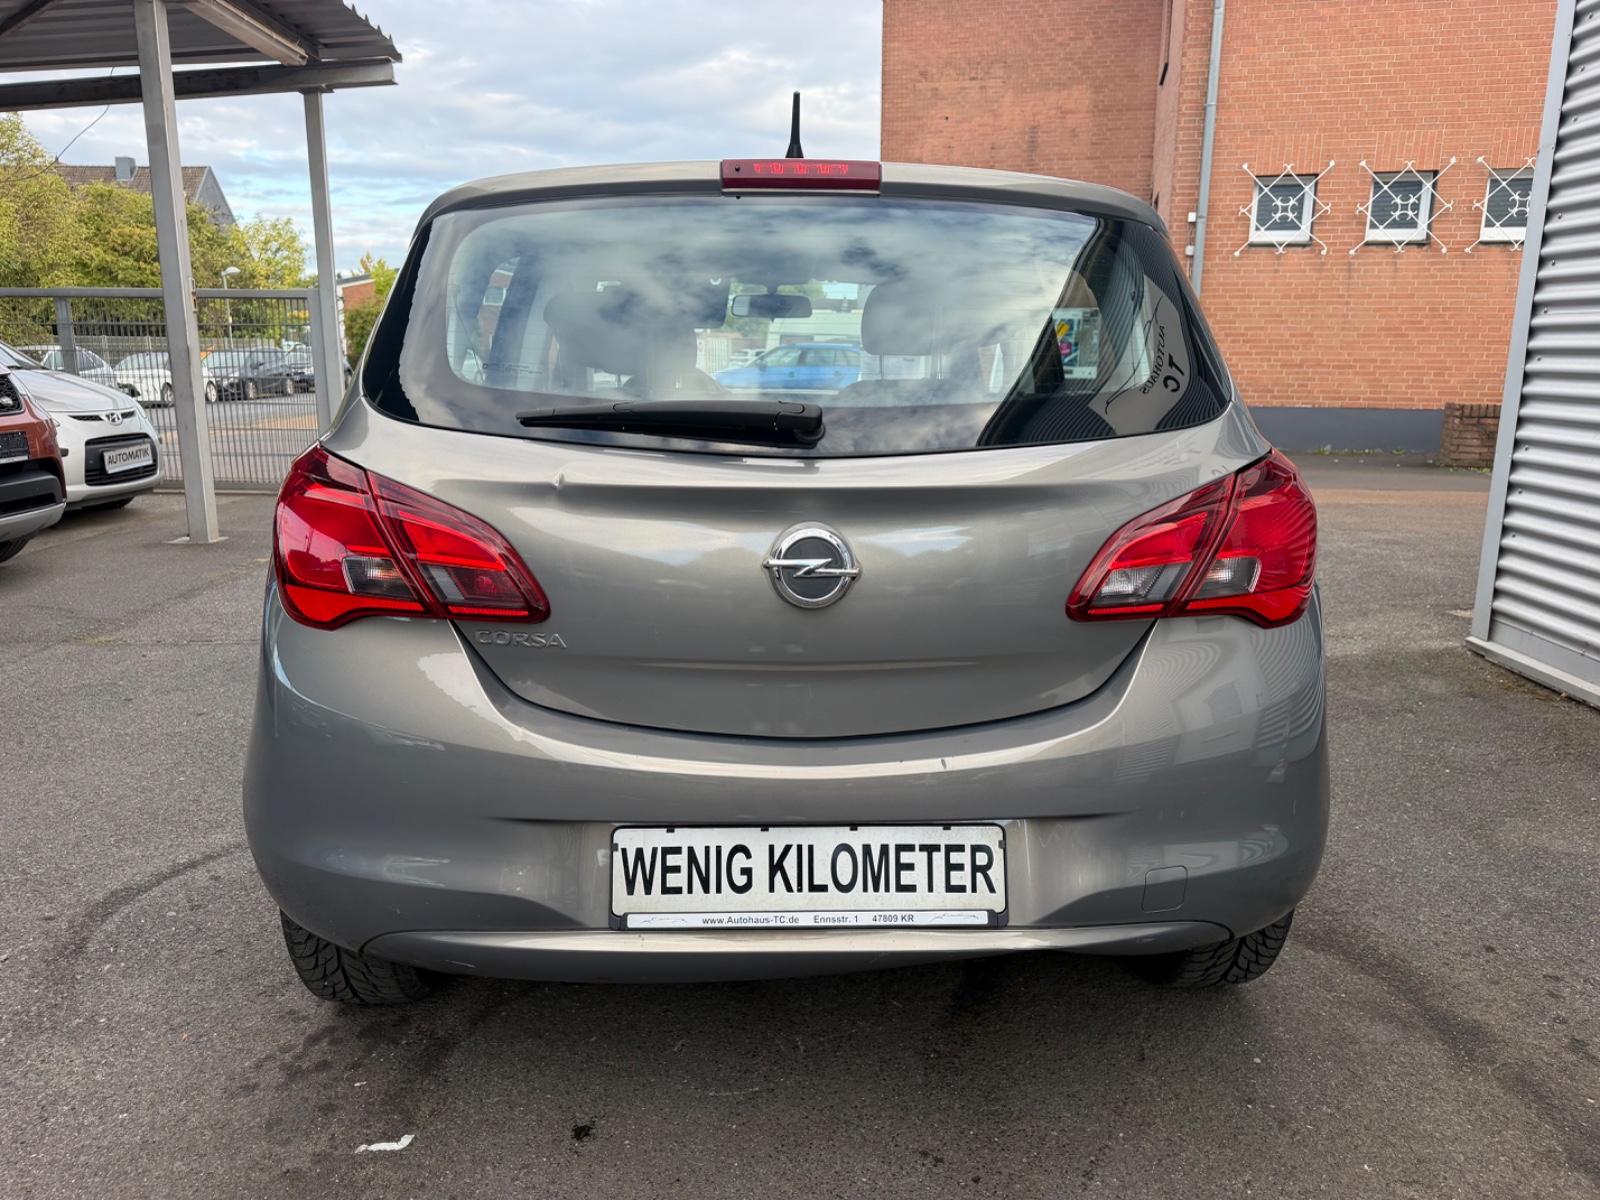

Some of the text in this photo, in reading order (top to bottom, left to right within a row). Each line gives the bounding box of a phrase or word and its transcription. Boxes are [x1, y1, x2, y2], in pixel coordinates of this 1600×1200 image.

[107, 447, 150, 465] AUTOMATIK
[475, 629, 567, 650] CORSA
[620, 843, 997, 896] WENIG KILOMETER
[702, 915, 800, 926] www.Autohaus-TC.de
[813, 914, 852, 924] Ennsstr.
[872, 914, 899, 923] 47809
[901, 913, 915, 922] KR
